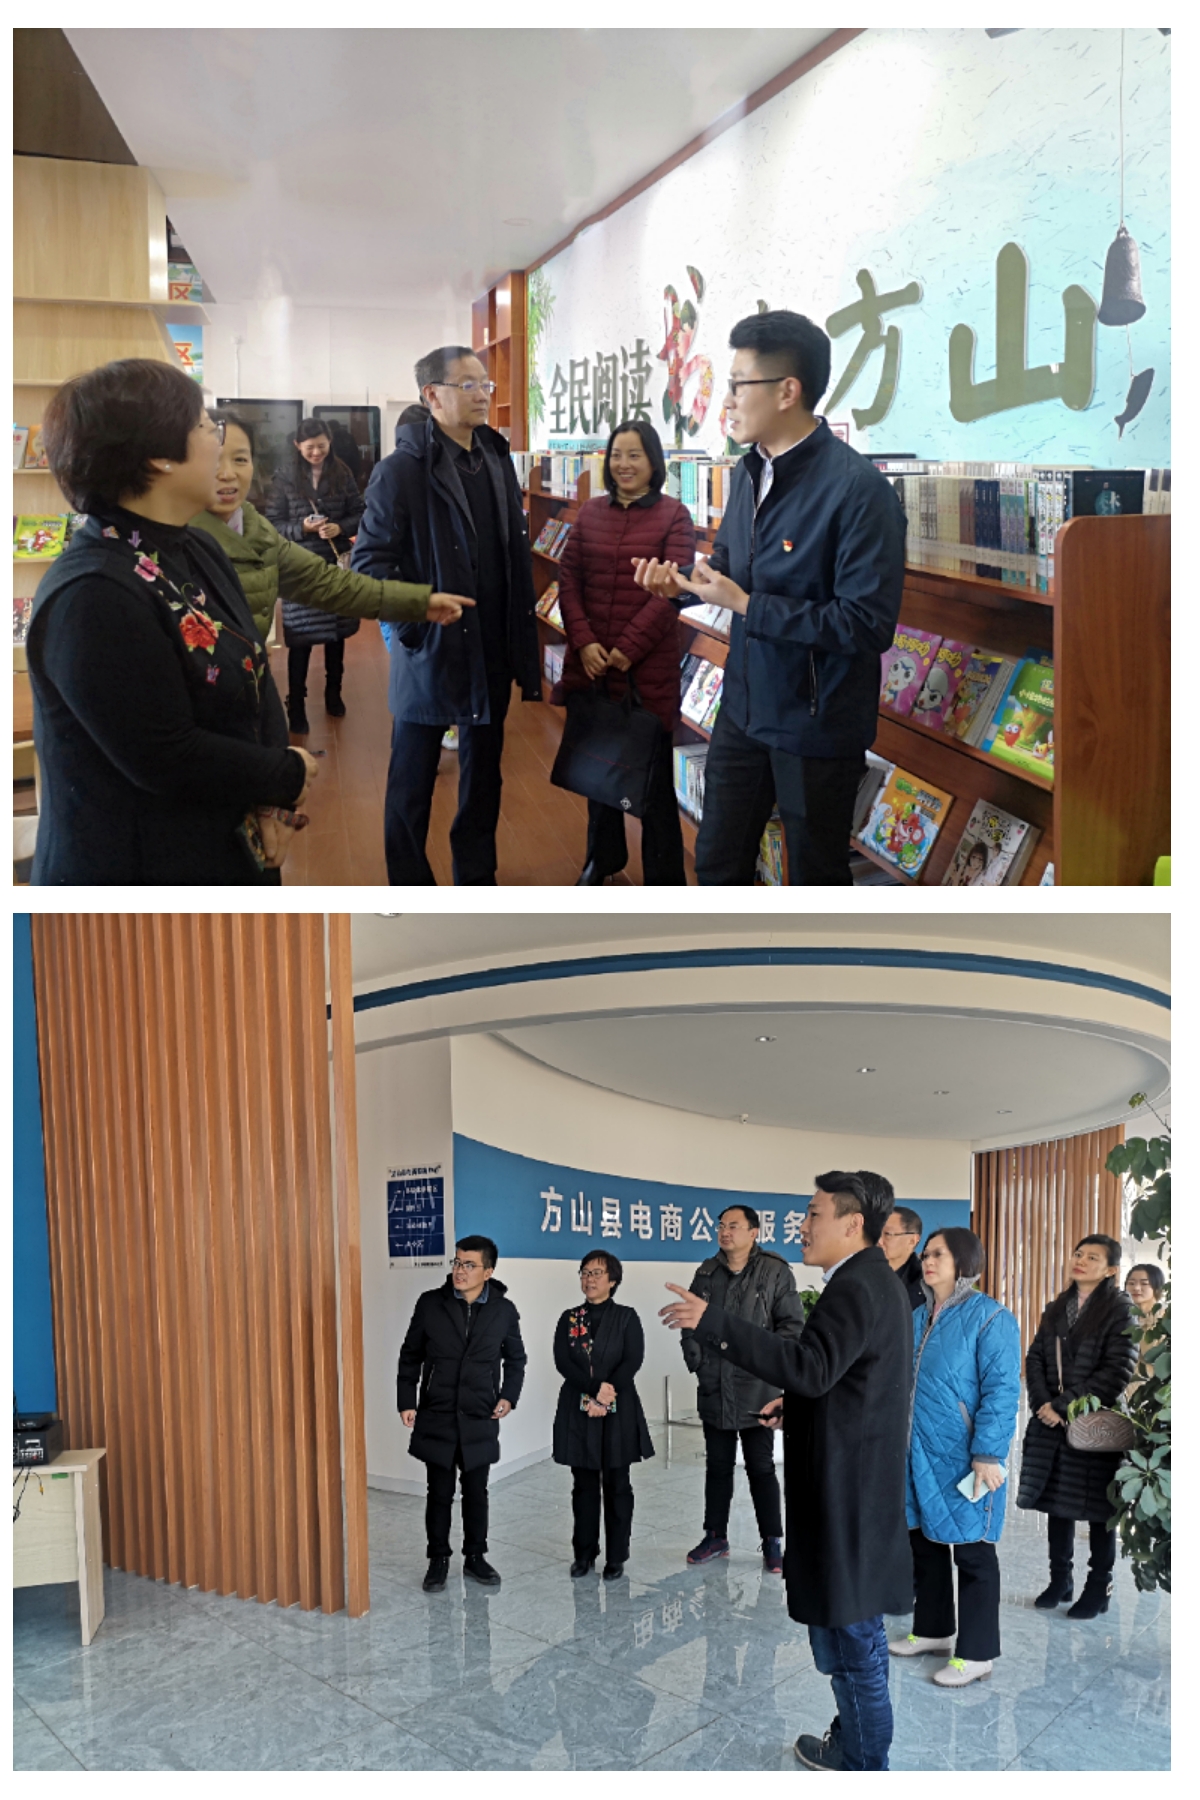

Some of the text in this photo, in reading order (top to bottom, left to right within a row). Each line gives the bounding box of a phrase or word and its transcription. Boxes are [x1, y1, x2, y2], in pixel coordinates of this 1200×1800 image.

[549, 338, 653, 435] 全民阅读
[539, 1185, 806, 1245] 方山县电商公服务
